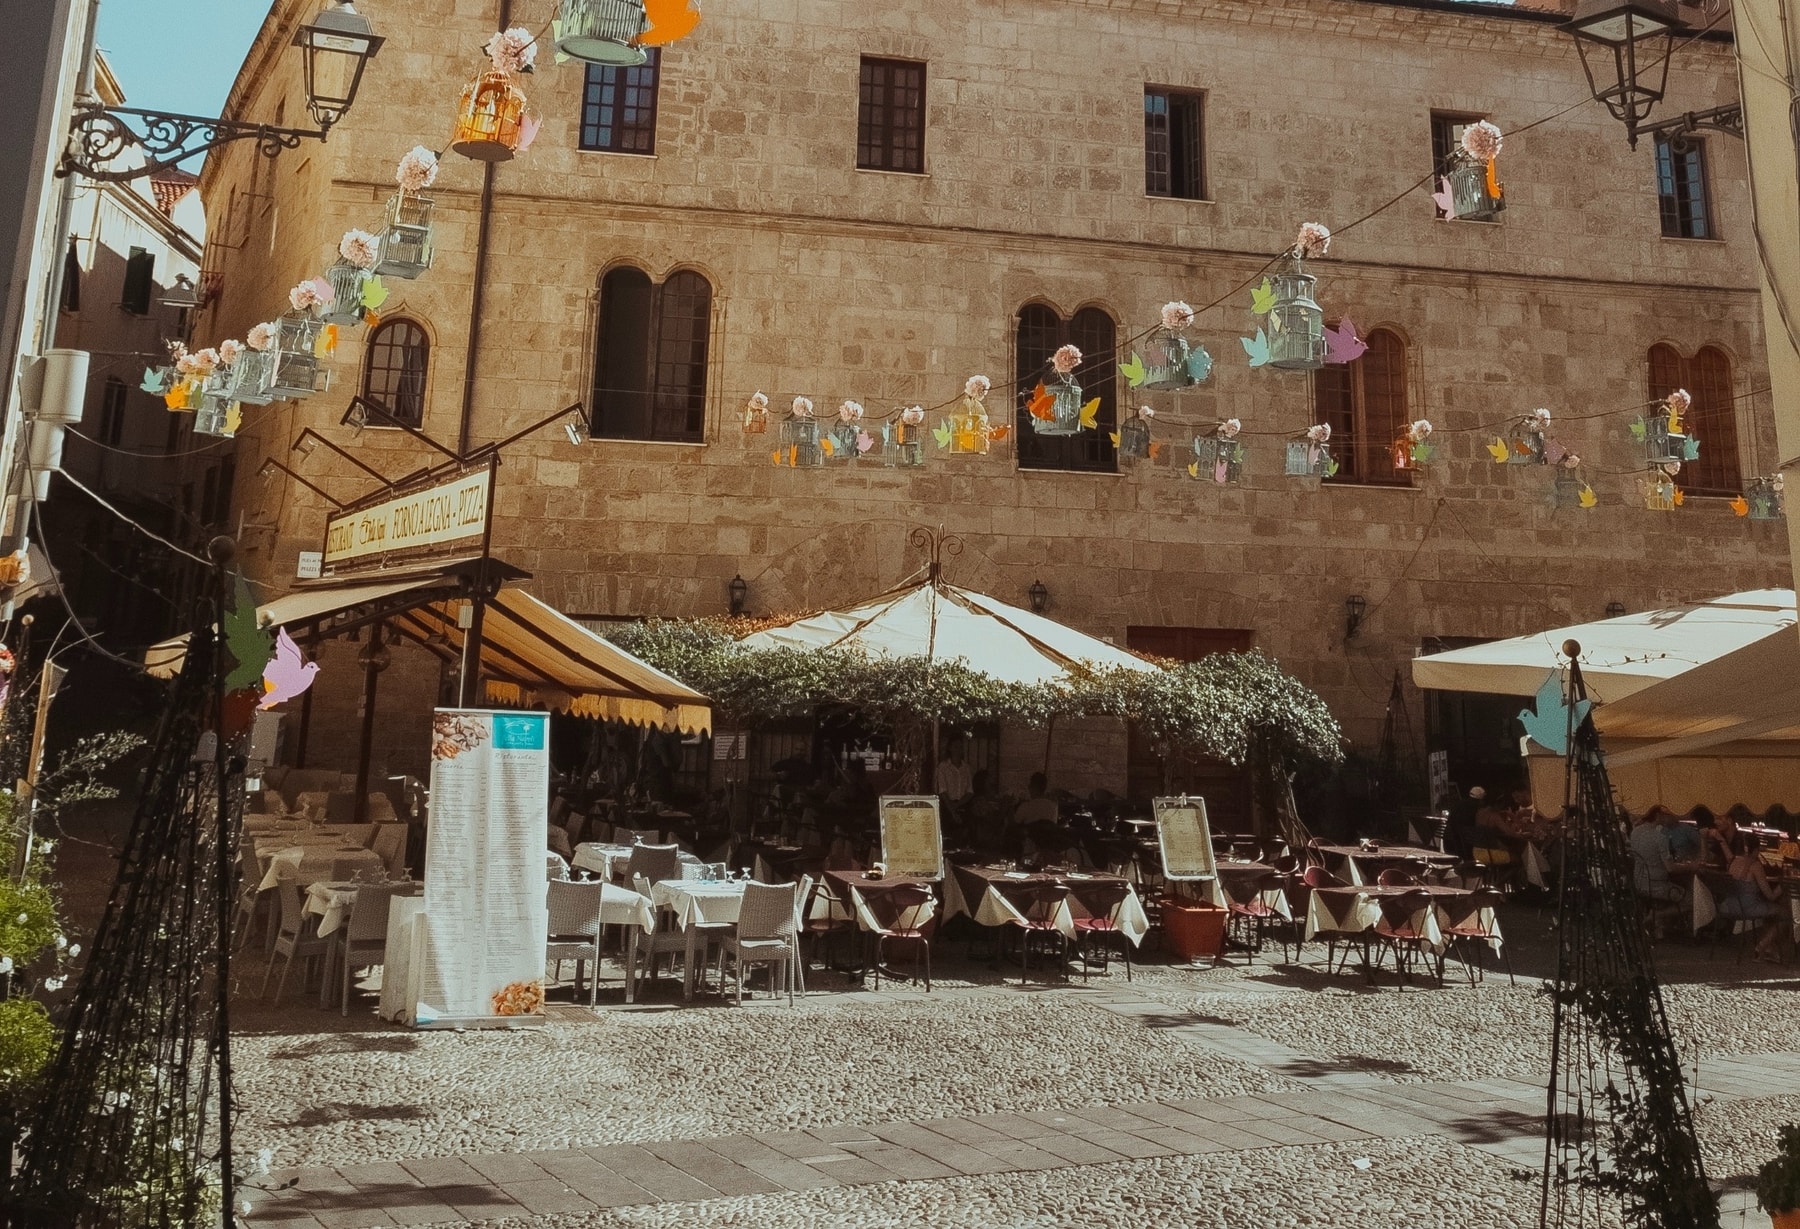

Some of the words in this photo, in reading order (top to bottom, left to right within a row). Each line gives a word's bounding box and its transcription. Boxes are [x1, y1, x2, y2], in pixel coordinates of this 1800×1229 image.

[392, 502, 418, 539] FORNO
[418, 500, 424, 535] A
[425, 494, 451, 533] LEGNA
[457, 482, 484, 526] PIZZA
